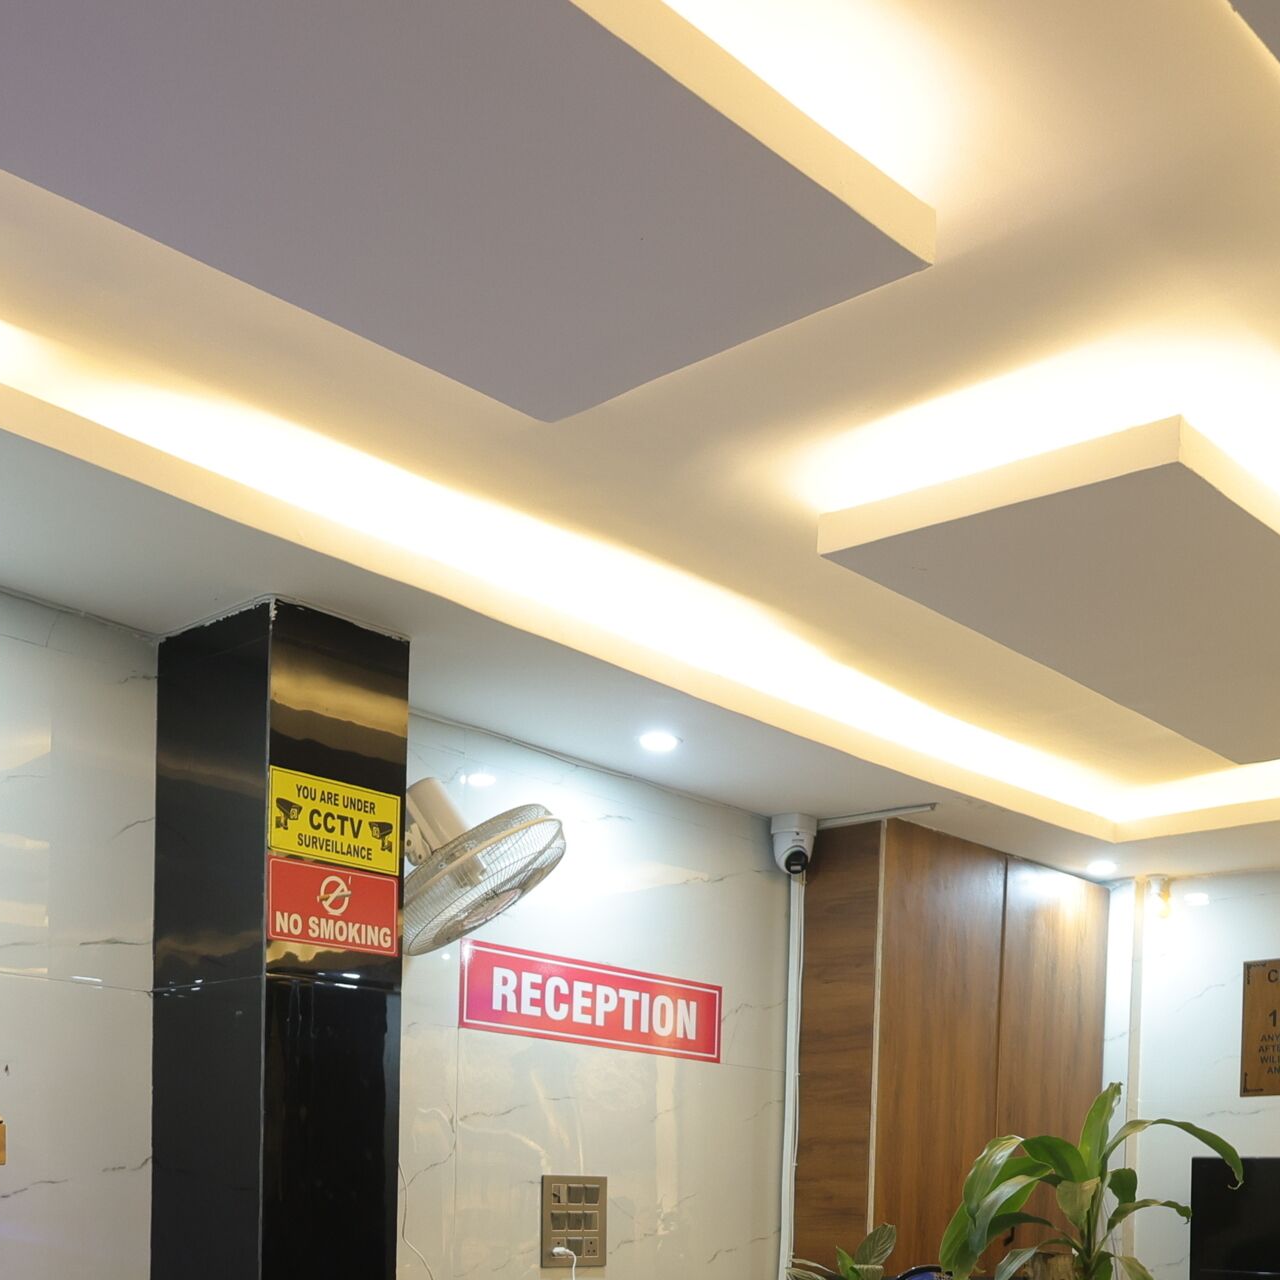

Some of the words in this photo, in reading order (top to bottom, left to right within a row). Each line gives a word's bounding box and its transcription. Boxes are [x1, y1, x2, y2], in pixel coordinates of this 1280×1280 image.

[296, 784, 316, 800] YOU
[320, 790, 339, 807] ARE
[343, 796, 375, 815] UNDER
[309, 809, 362, 839] CCTV
[298, 833, 372, 860] SURVEILLANCE
[276, 911, 302, 935] NO
[308, 916, 392, 948] SMOKING
[492, 966, 697, 1040] RECEPTION
[1261, 1034, 1280, 1042] ANY
[1267, 1066, 1280, 1074] AN
